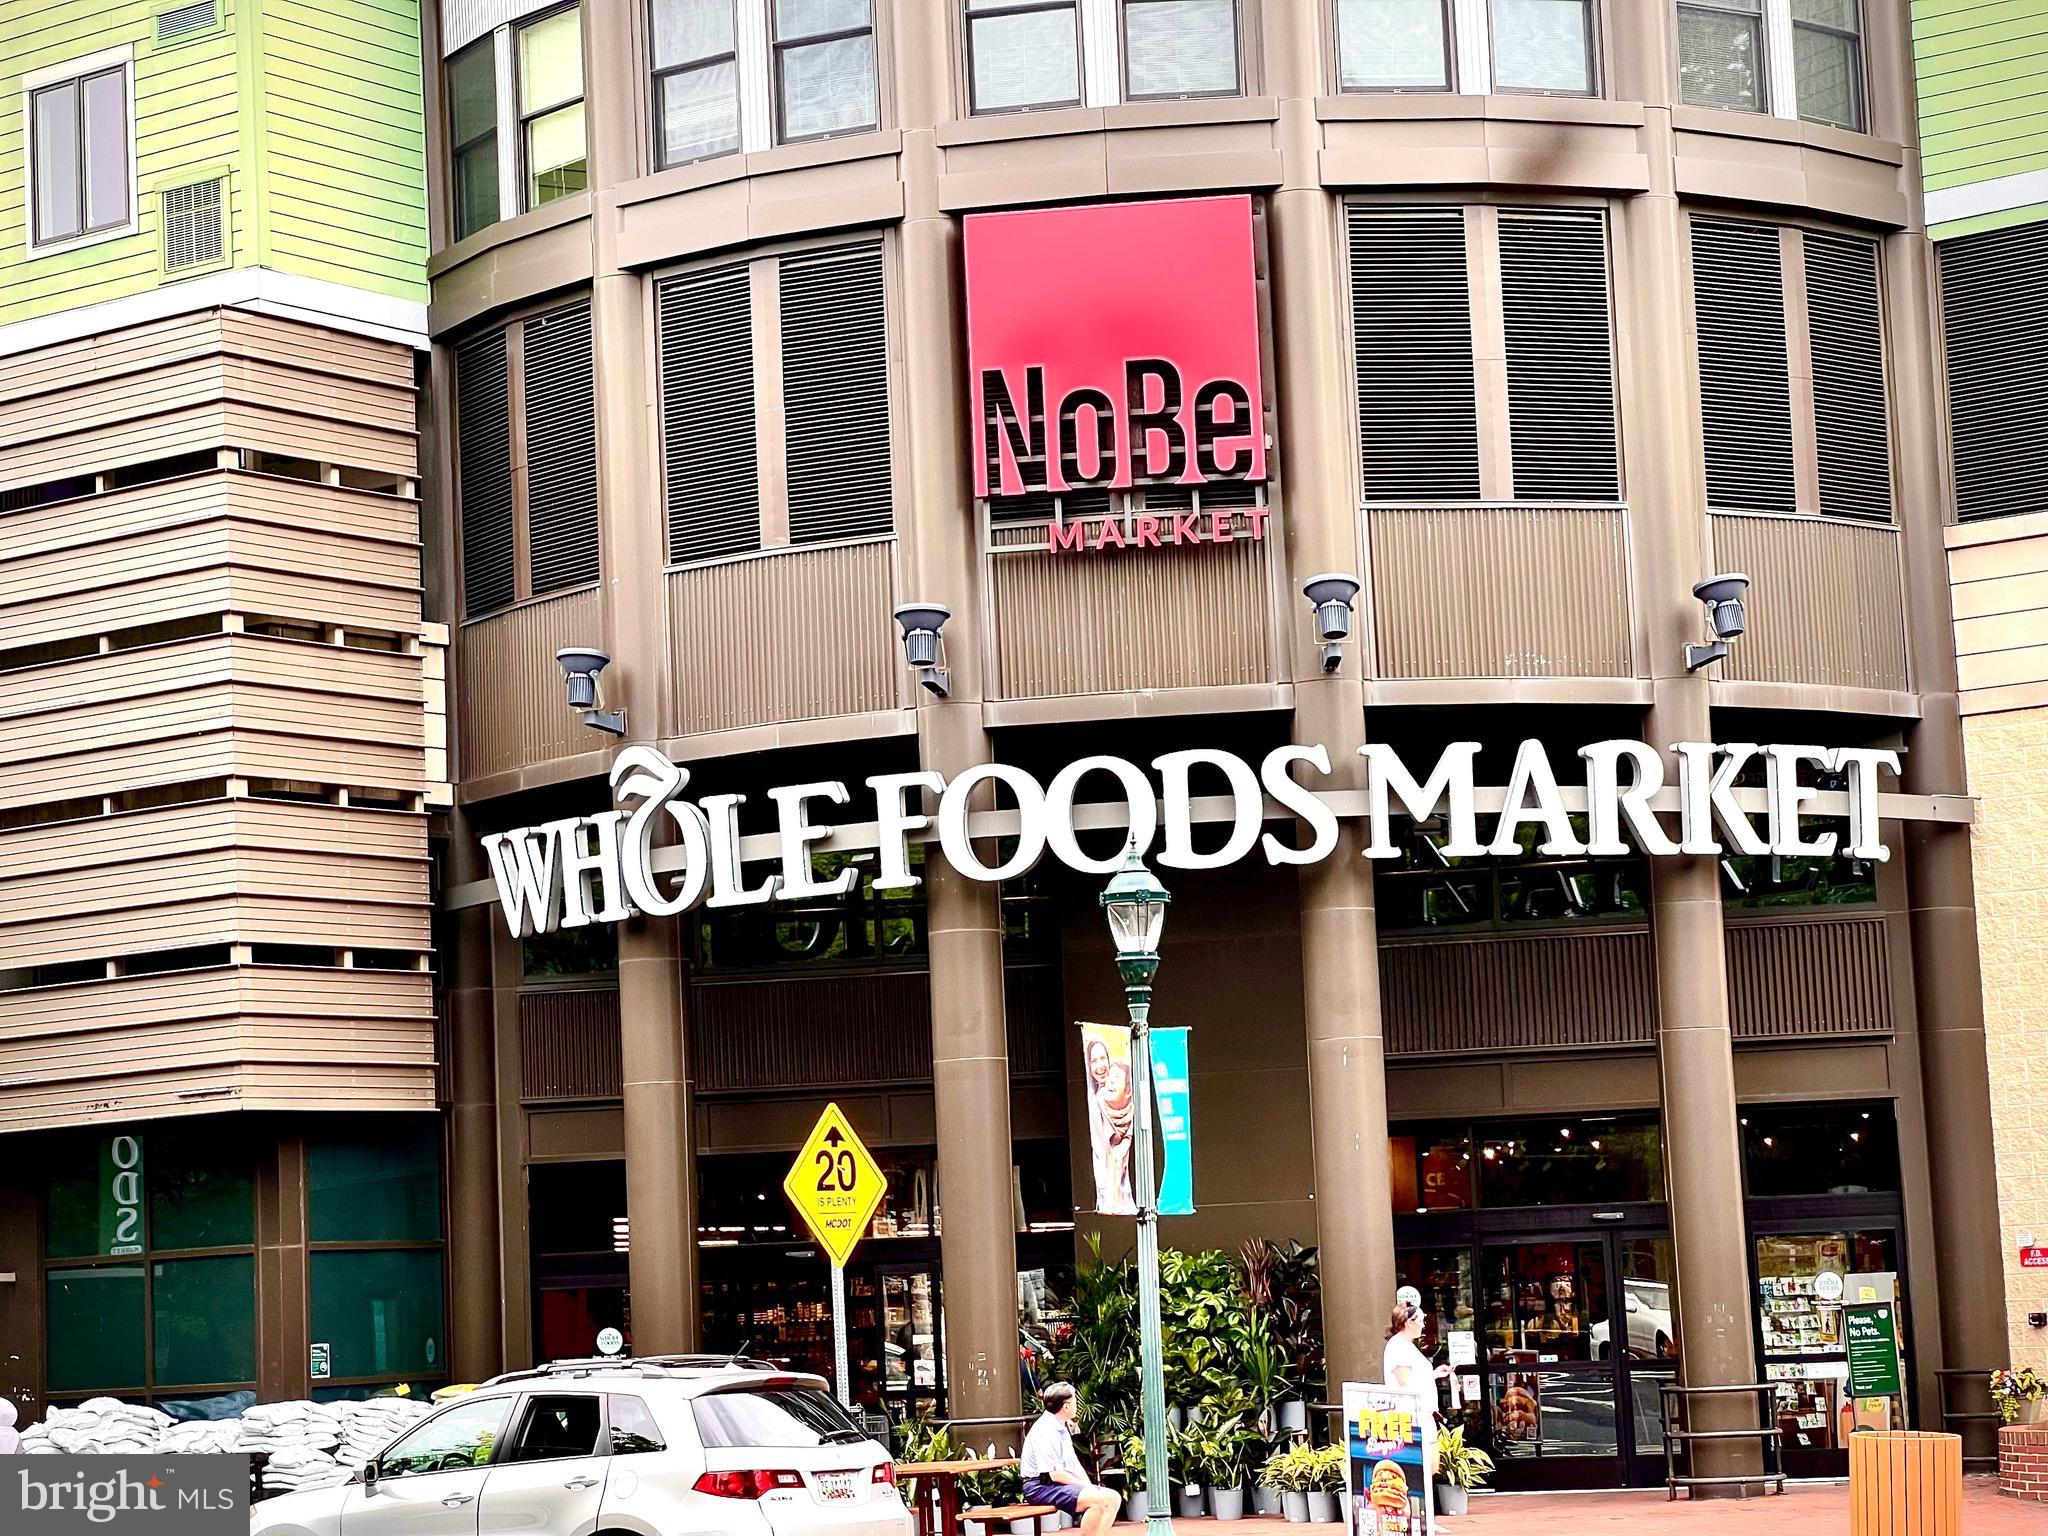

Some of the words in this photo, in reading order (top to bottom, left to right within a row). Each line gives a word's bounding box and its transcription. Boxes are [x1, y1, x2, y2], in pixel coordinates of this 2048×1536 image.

[981, 358, 1253, 495] NoBe
[1049, 509, 1270, 554] MARKET
[480, 745, 859, 938] WHOLE
[865, 743, 1339, 889] FOODS
[1356, 738, 1901, 862] MARKET
[815, 1149, 857, 1192] 20
[817, 1197, 825, 1207] IS
[827, 1196, 857, 1207] PLENTY
[825, 1218, 852, 1229] MCDOT
[2030, 1249, 2043, 1258] F.D.
[1847, 1315, 1874, 1326] Please,
[1849, 1327, 1861, 1337] No
[1861, 1326, 1880, 1336] Pets.
[1359, 1409, 1413, 1443] FREE
